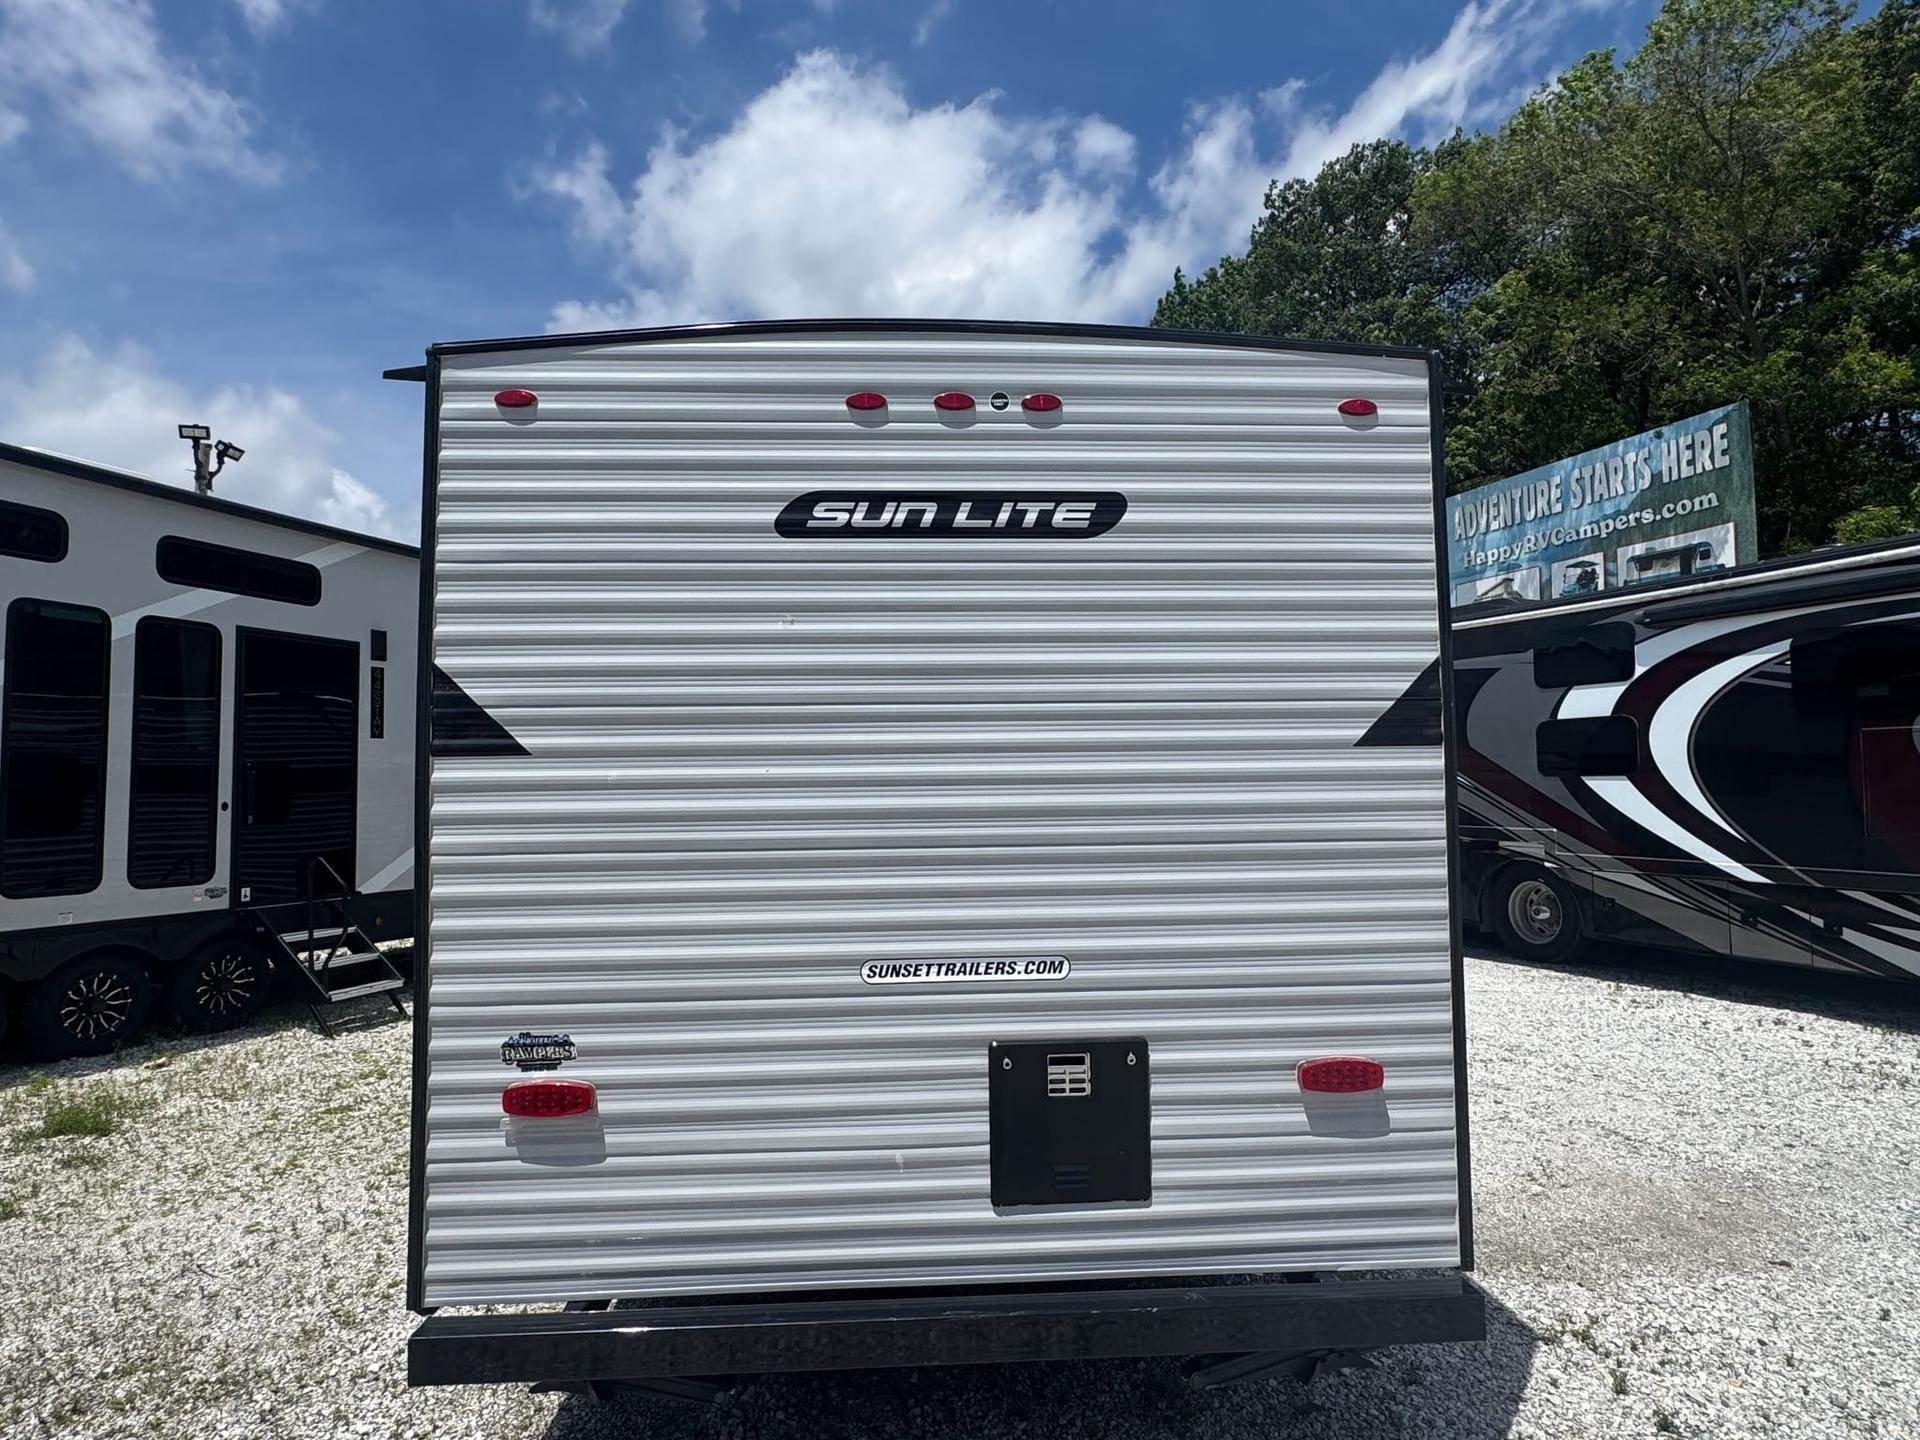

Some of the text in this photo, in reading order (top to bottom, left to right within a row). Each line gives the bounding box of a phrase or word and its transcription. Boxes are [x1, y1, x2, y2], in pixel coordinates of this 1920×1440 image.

[1454, 423, 1731, 541] ADVENTURE STARTS HERE
[806, 502, 1097, 528] SUN LITE
[1463, 490, 1719, 568] HappyRVCampers.com
[867, 960, 1064, 979] SUNSETTRAILERS.COM
